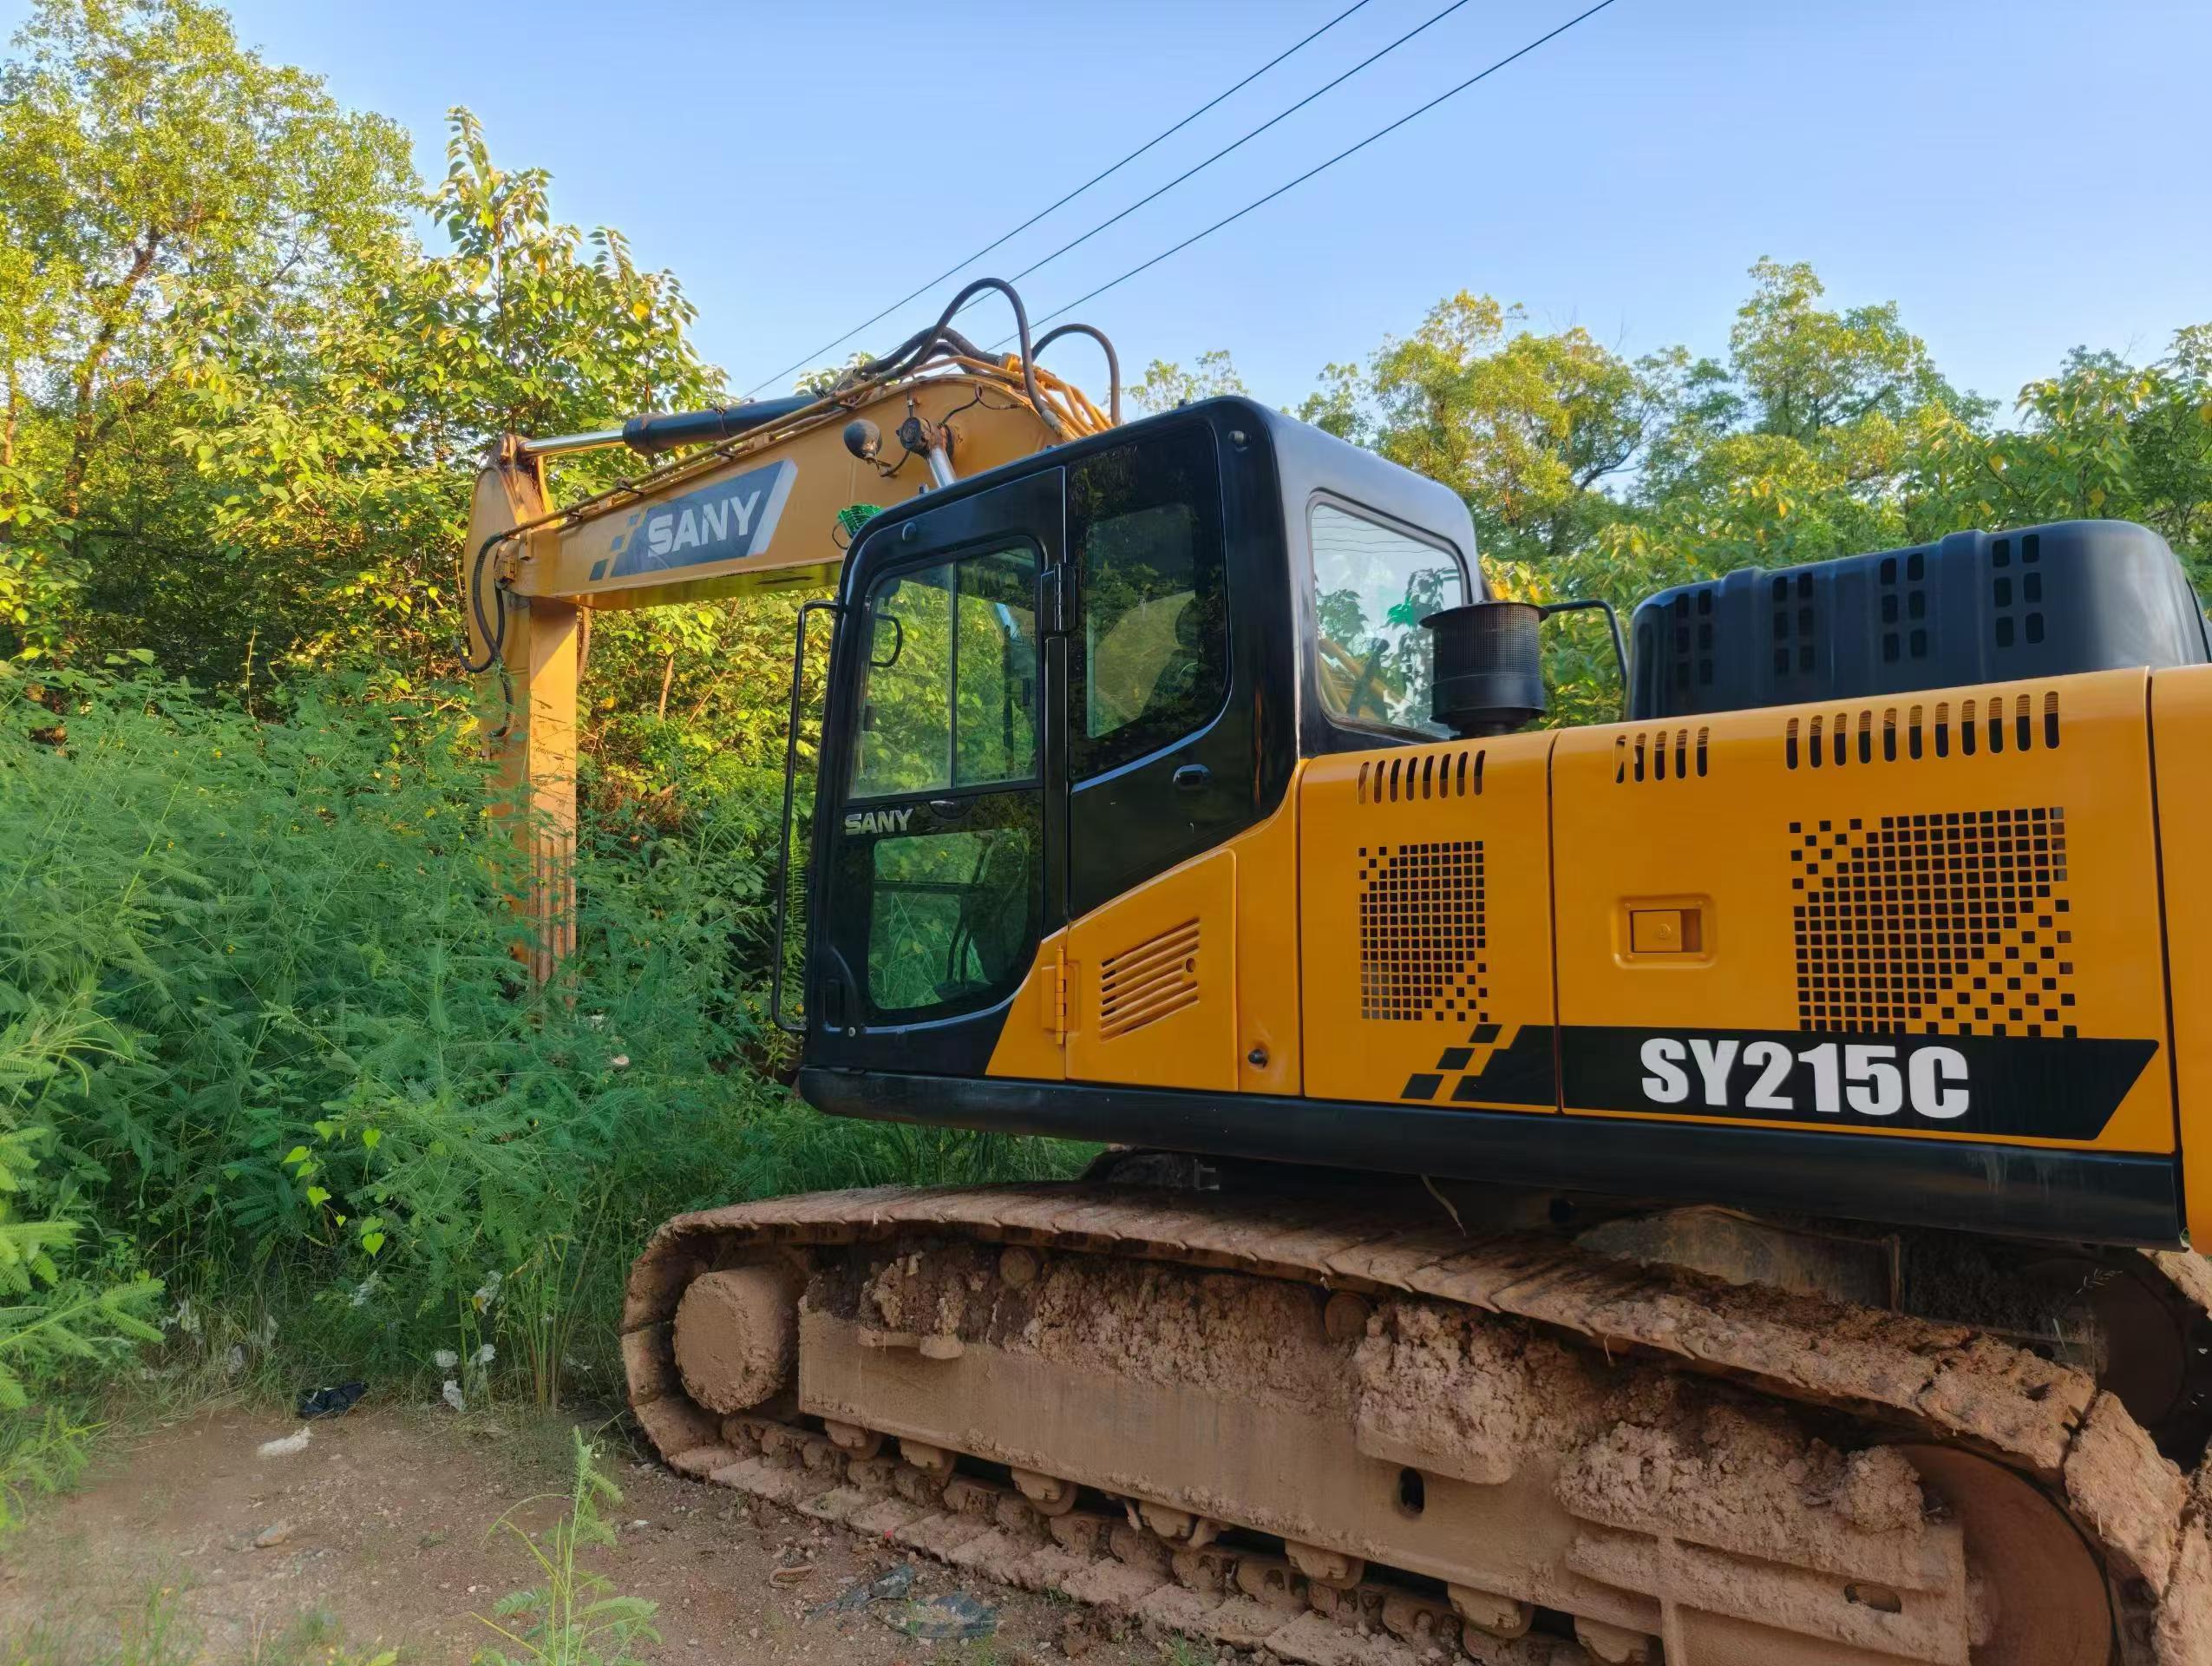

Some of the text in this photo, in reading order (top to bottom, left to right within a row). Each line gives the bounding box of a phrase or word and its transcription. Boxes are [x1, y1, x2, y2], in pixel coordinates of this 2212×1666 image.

[648, 489, 761, 557] SANY
[845, 808, 913, 836] SANY
[1640, 1038, 1969, 1118] SY215C
